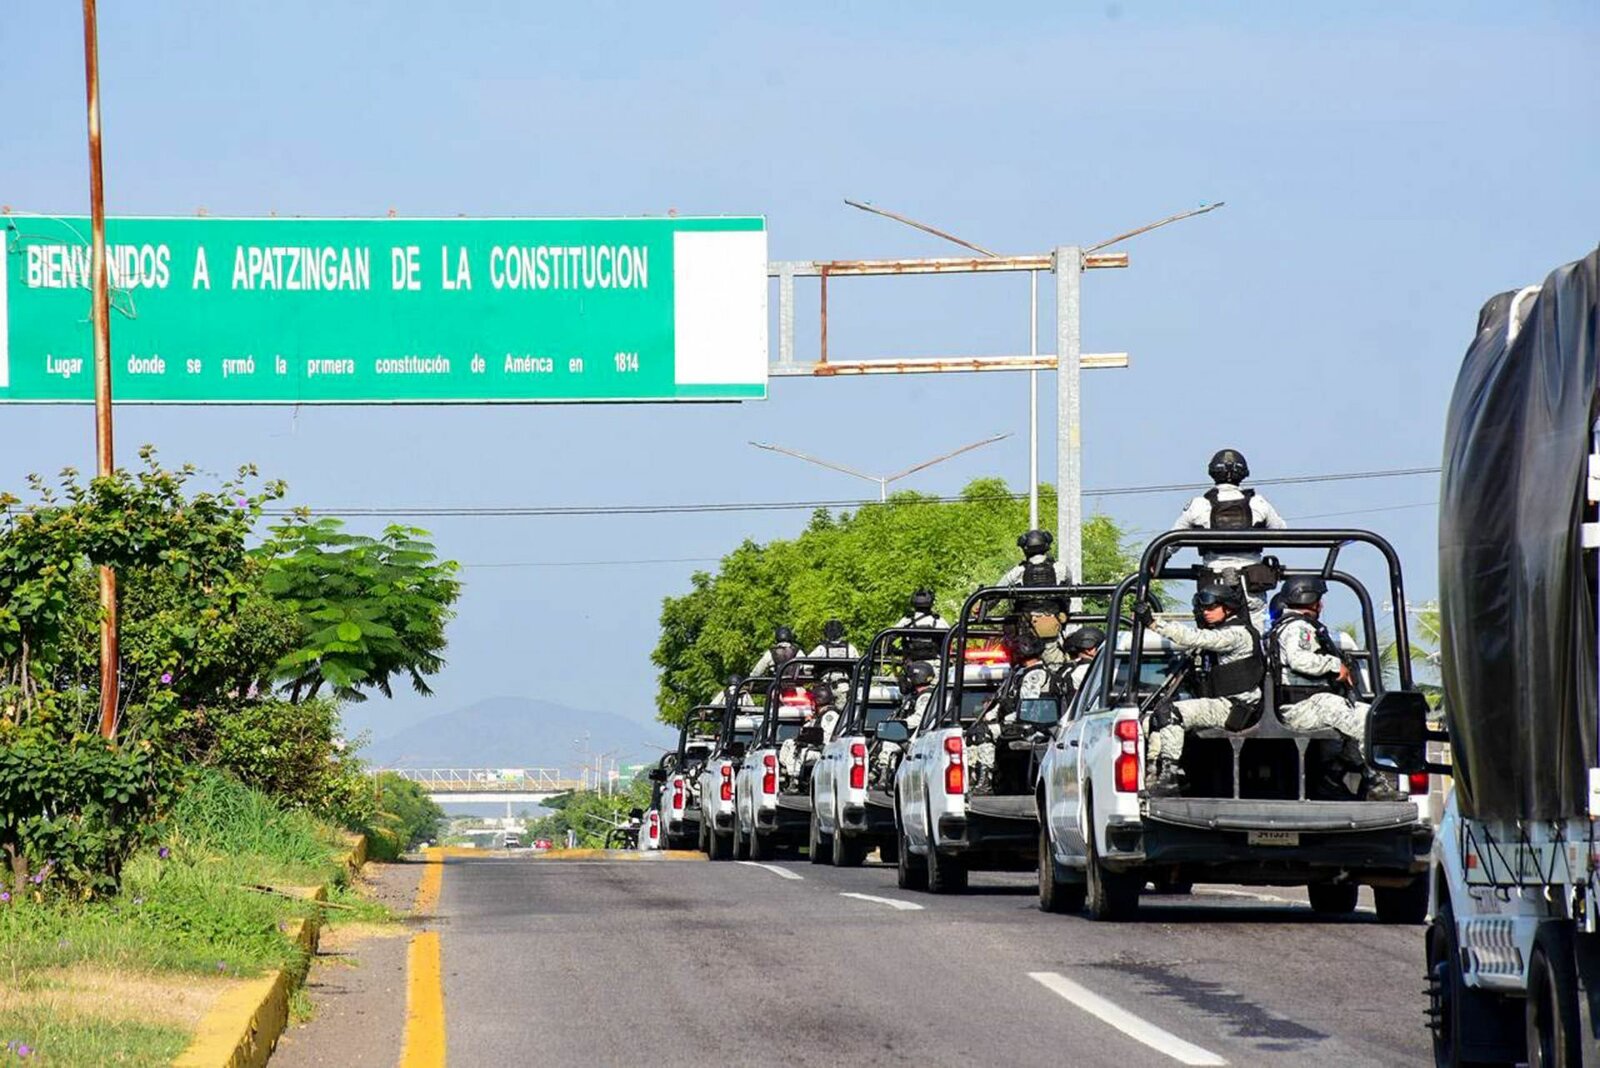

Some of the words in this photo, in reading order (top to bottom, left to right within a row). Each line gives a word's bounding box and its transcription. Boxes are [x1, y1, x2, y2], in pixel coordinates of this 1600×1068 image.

[27, 244, 170, 288] BIENVNIDOS
[193, 247, 210, 289] A
[232, 246, 370, 290] APATZINGAN
[392, 246, 421, 290] DE
[442, 246, 471, 289] LA
[490, 245, 648, 289] CONSTITUCION
[46, 354, 83, 378] Lugar
[128, 354, 165, 374] donde
[187, 359, 201, 374] se
[223, 355, 255, 377] firmó
[276, 355, 286, 374] la
[308, 358, 354, 376] primera
[375, 354, 450, 374] constitución
[471, 354, 485, 373] de
[505, 353, 553, 373] América
[569, 358, 583, 372] en
[615, 353, 639, 372] 1814
